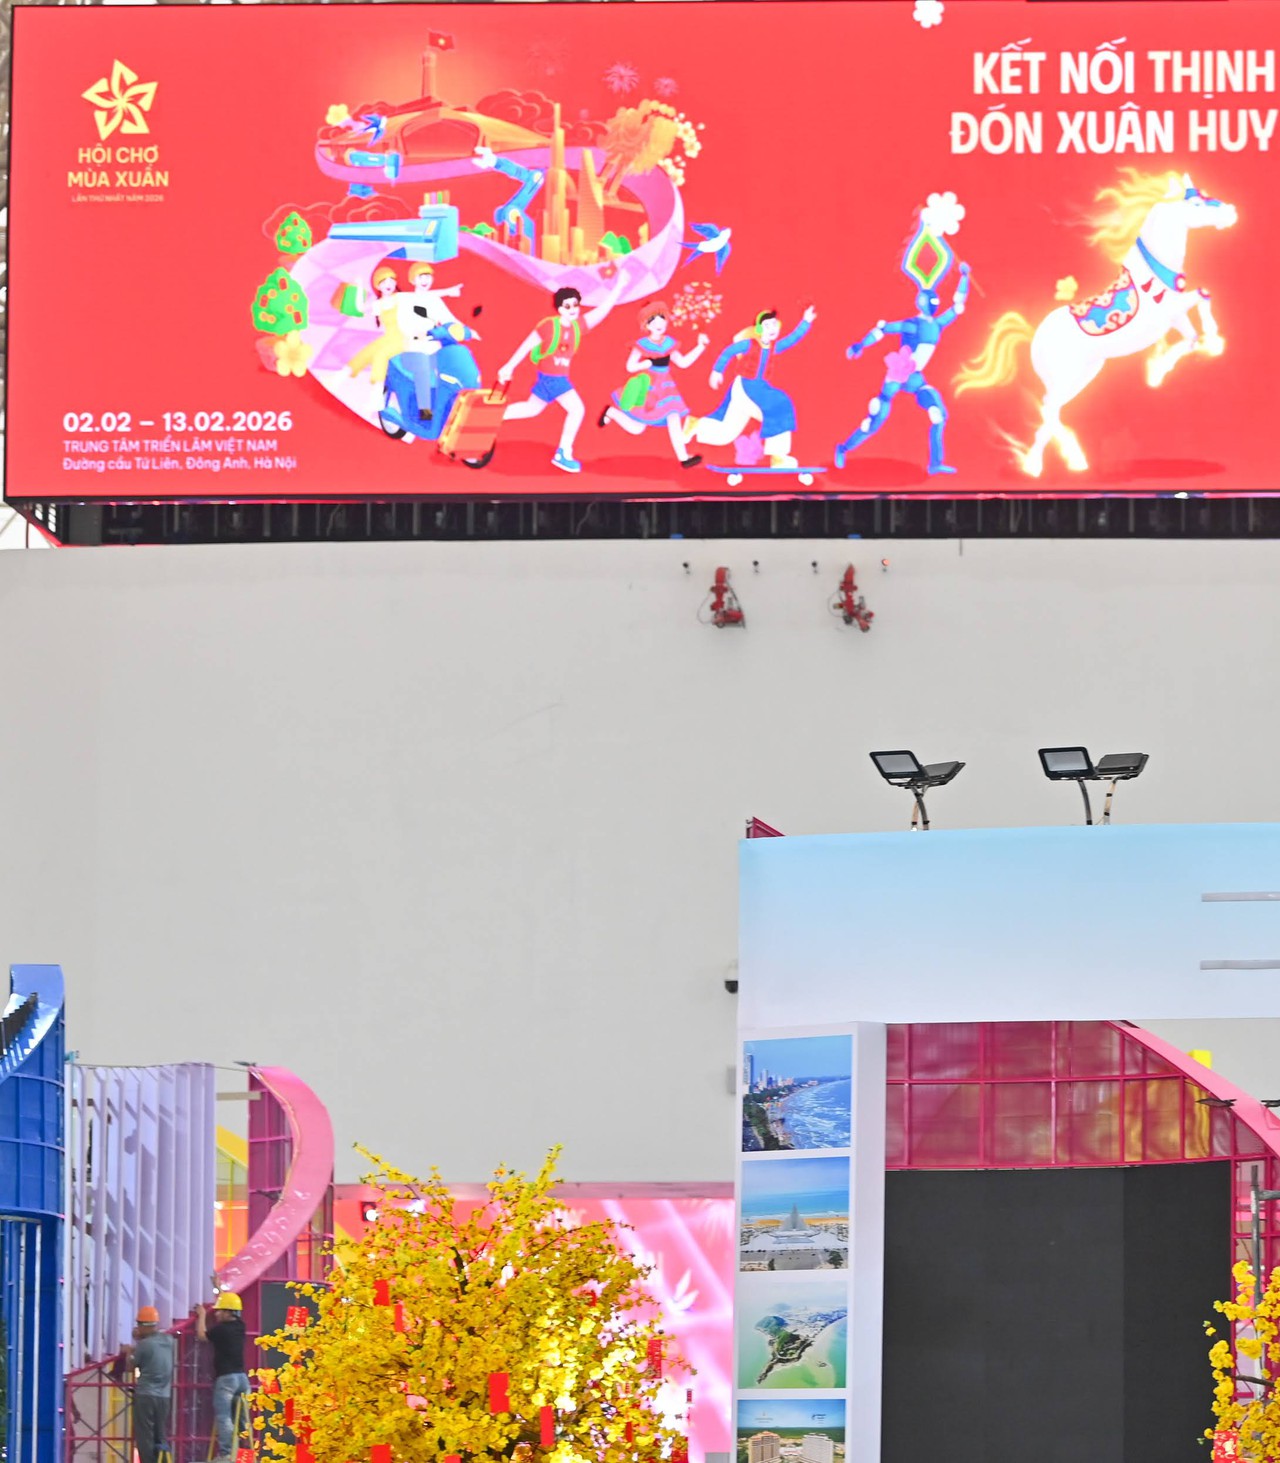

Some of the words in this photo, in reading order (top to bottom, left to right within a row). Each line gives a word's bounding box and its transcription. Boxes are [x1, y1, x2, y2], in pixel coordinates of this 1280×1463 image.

[973, 37, 1046, 95] KẾT
[1060, 36, 1135, 95] NỐI
[1147, 50, 1275, 99] THỊNH
[949, 104, 1043, 154] ĐÓN
[1056, 102, 1174, 154] XUÂN
[1188, 108, 1279, 153] HUY
[78, 143, 112, 167] HỘI
[115, 145, 160, 167] CHỢ
[67, 168, 110, 188] MÙA
[115, 167, 169, 188] XUÂN
[63, 412, 131, 432] 02.02
[162, 411, 293, 432] 13.02.2026
[63, 440, 109, 453] TRUNG
[112, 437, 140, 453] TÂM
[215, 436, 244, 455] VIỆT
[246, 439, 277, 452] NAM
[63, 457, 106, 473] Đường
[254, 456, 273, 469] Hà
[274, 456, 297, 472] Nội
